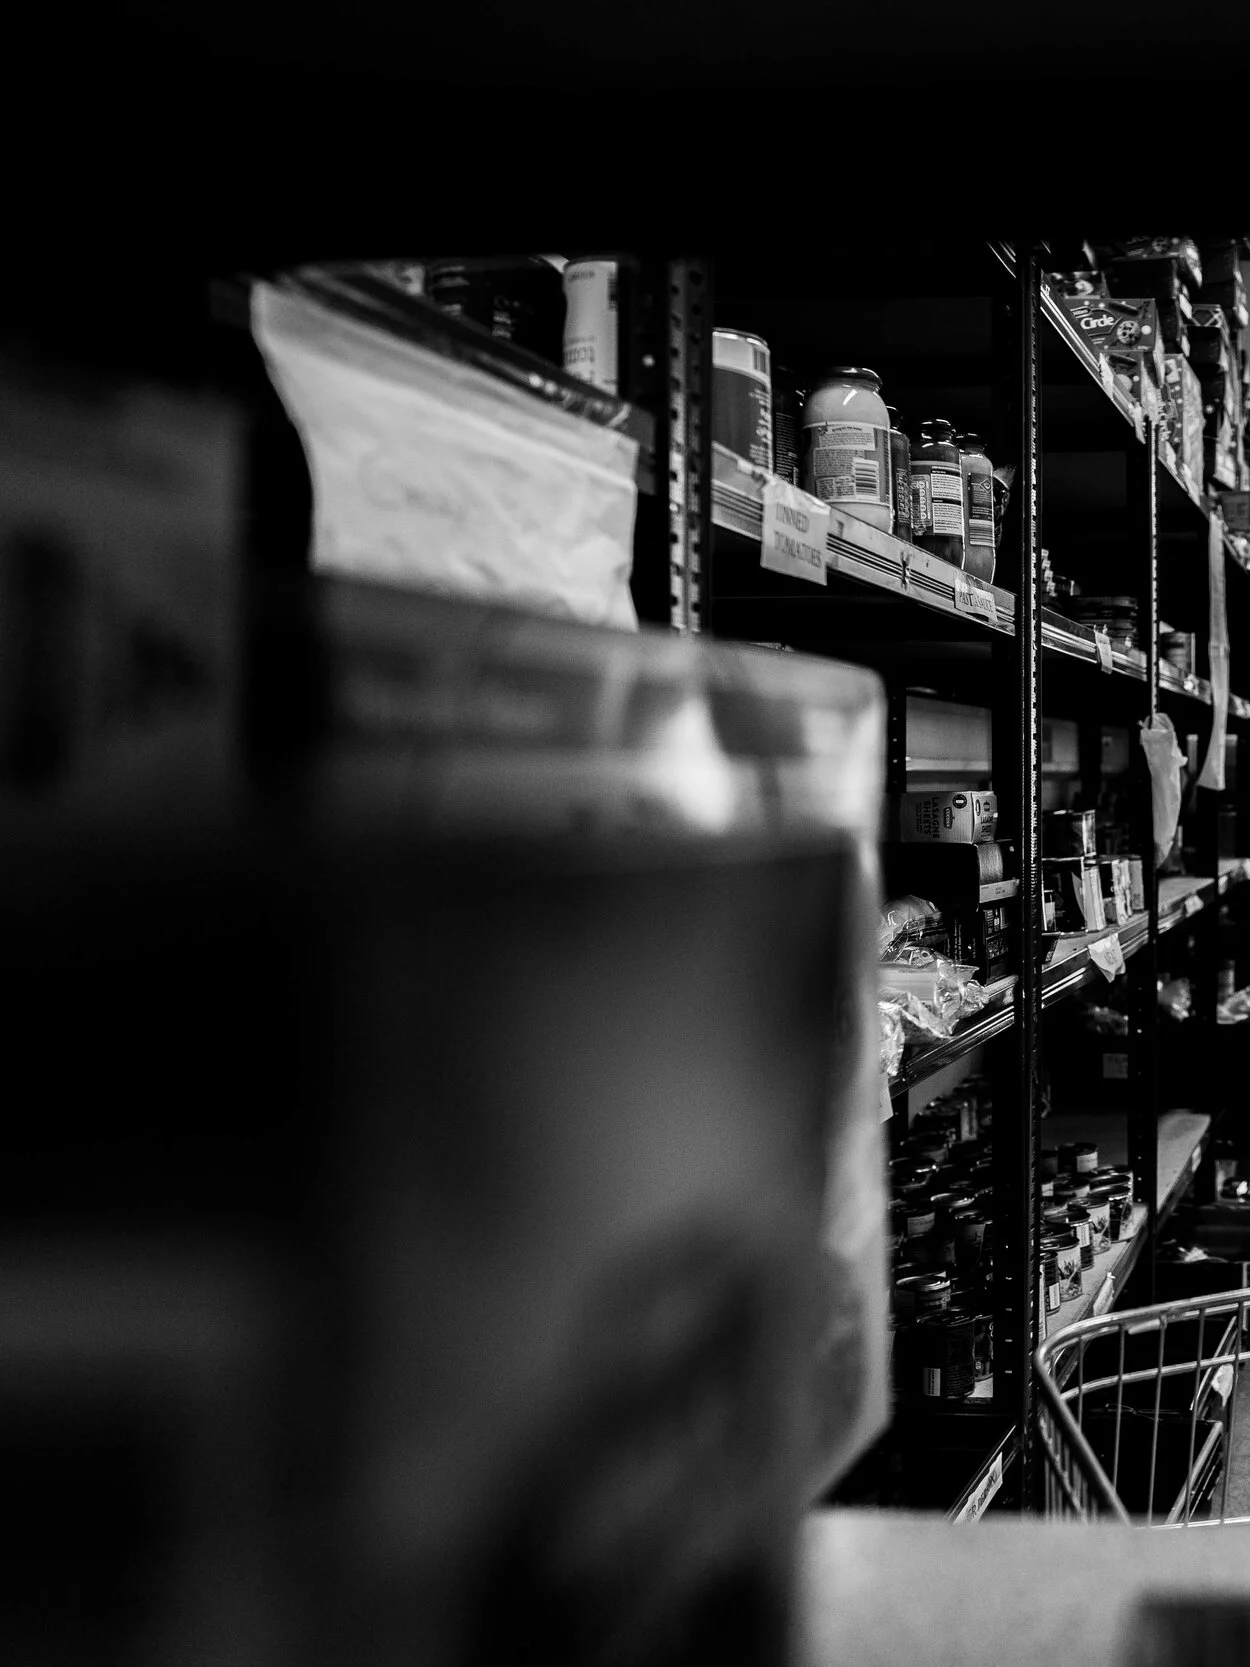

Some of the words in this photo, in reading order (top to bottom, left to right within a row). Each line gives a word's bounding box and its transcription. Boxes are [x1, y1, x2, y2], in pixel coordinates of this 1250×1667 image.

[1080, 314, 1115, 330] Circle
[923, 800, 932, 835] SHEETS
[932, 796, 940, 839] LASAGNE
